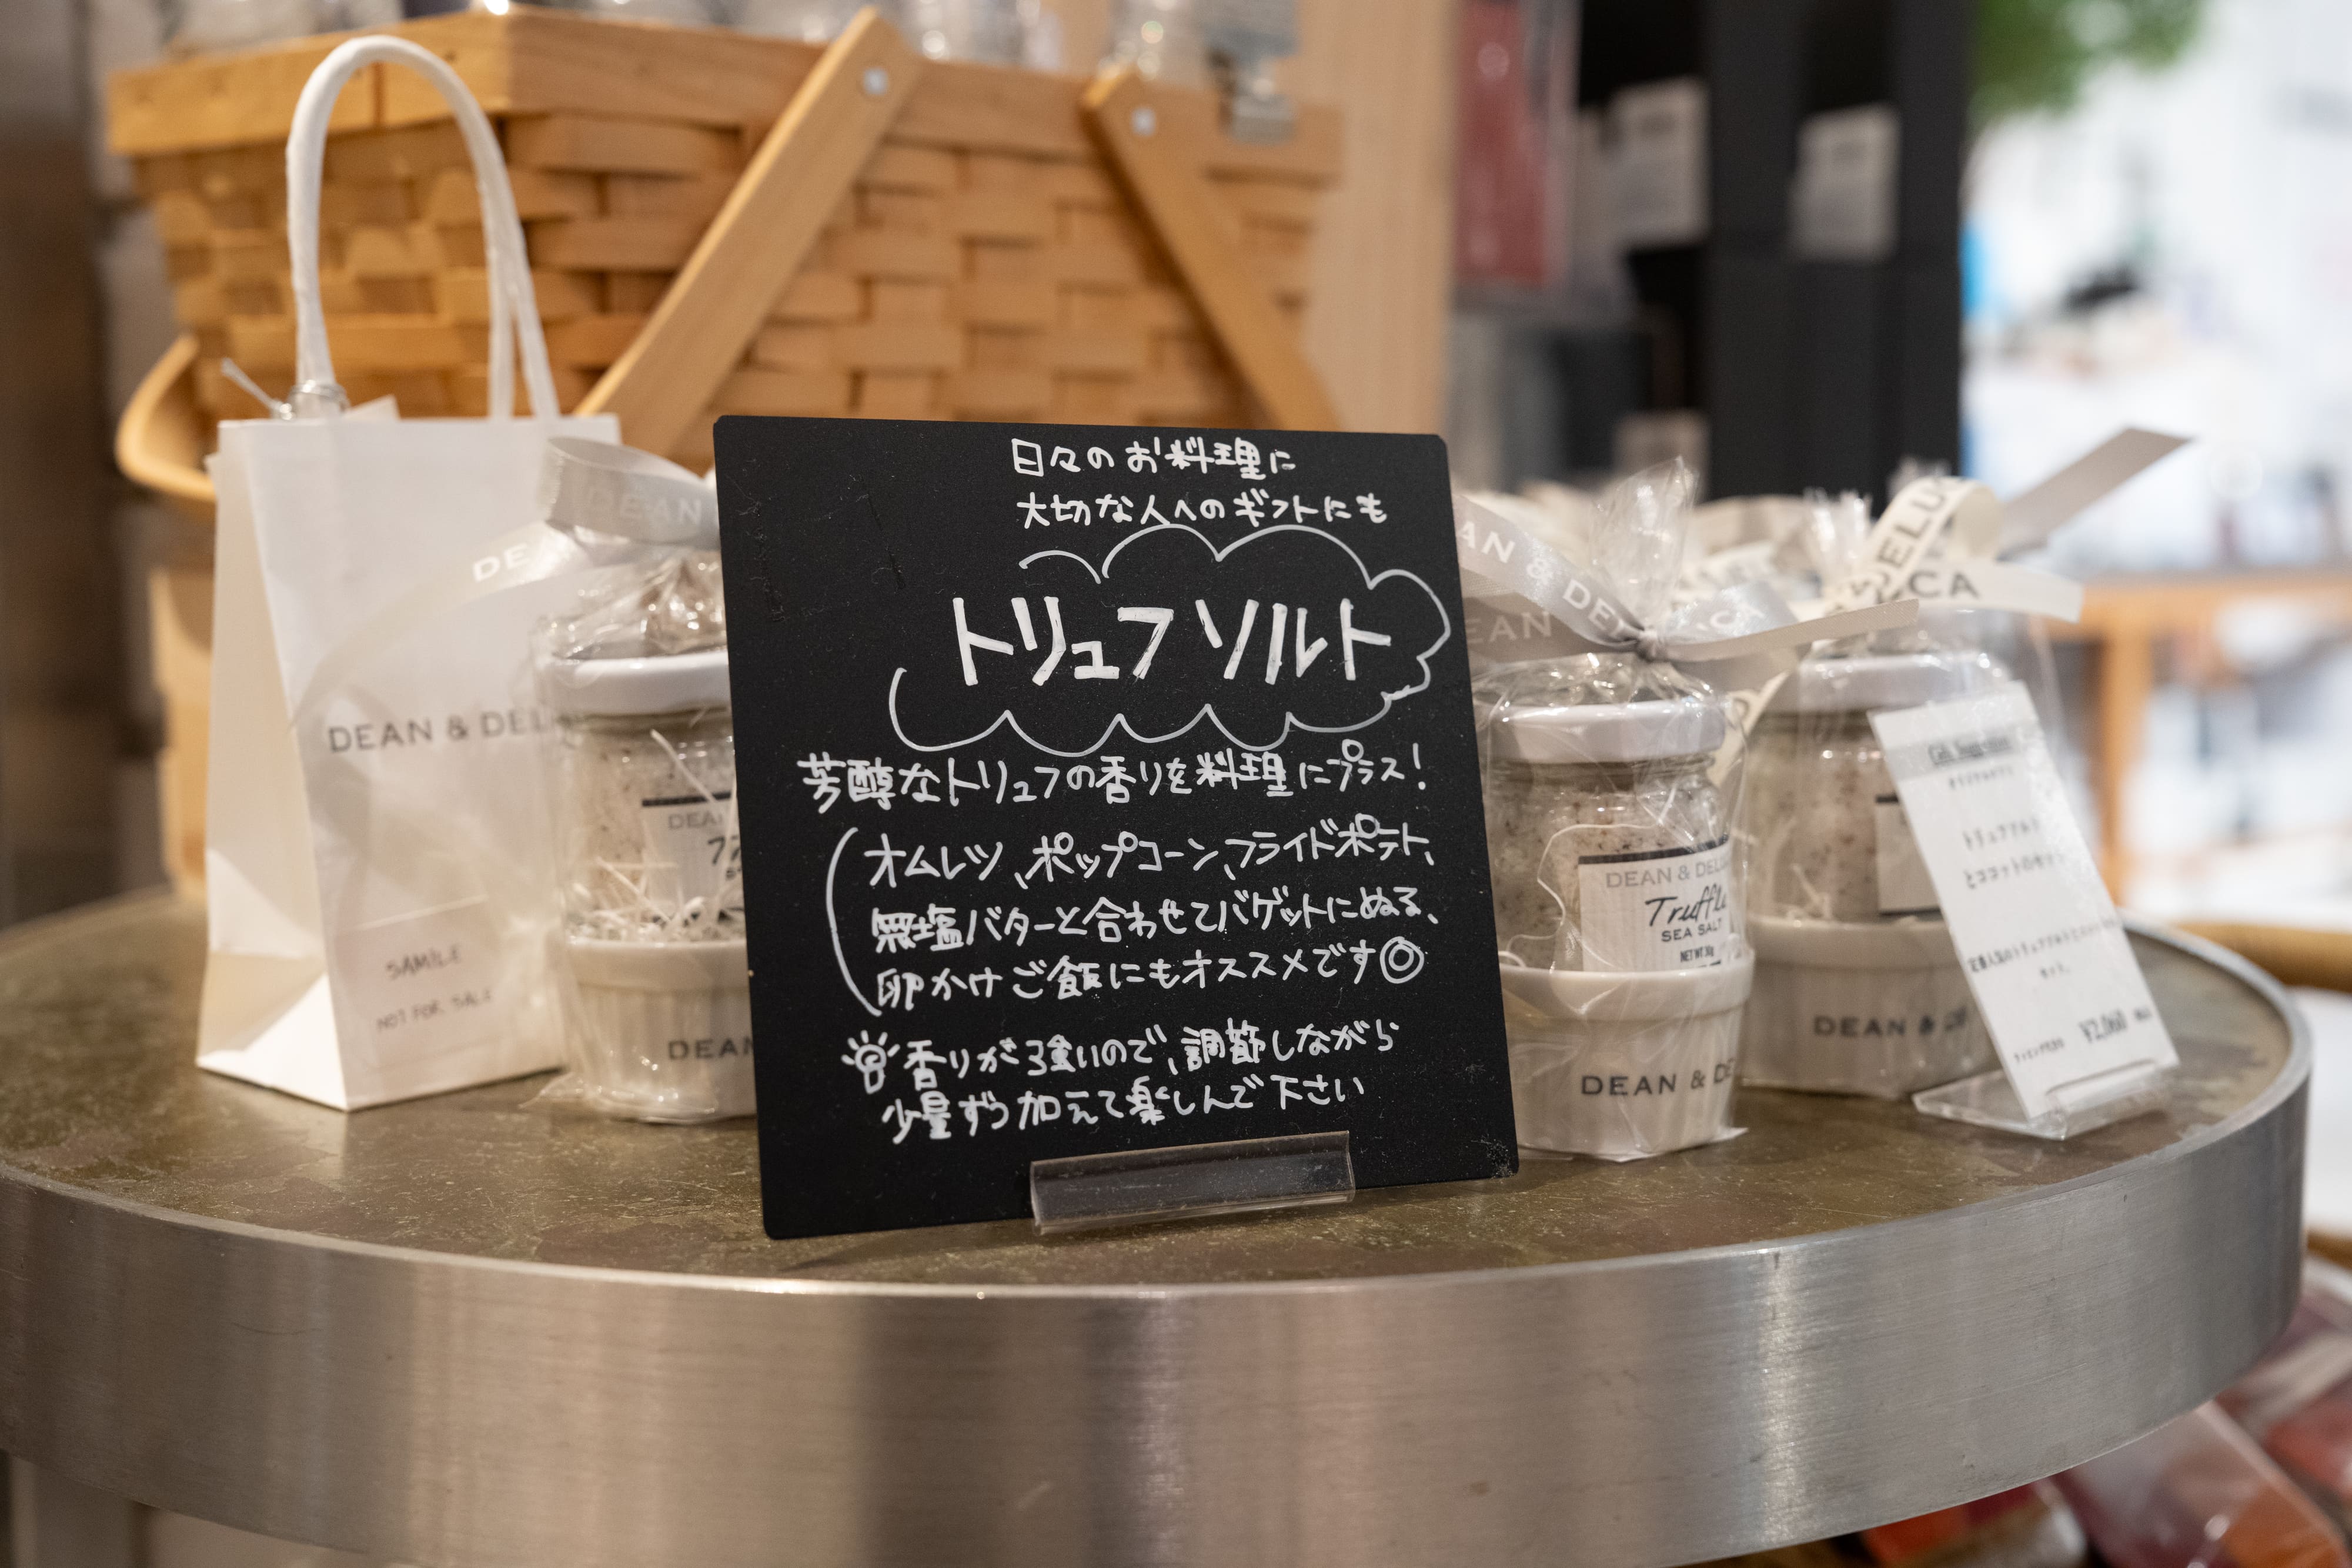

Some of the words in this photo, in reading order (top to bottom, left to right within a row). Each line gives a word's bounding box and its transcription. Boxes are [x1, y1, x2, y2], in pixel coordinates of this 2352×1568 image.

[1011, 436, 1296, 480] 日々のお料理に
[1016, 489, 1387, 529] 大切な人へのギフトにも
[329, 717, 432, 754] DEAN
[447, 713, 468, 741] &
[1606, 867, 1672, 888] DEAN
[1678, 864, 1690, 880] &
[1661, 927, 1692, 942] SEA
[1698, 918, 1722, 936] SALT
[1813, 1015, 1906, 1037] DEAN
[1582, 1073, 1676, 1096] DEAN
[1690, 1069, 1705, 1089] &
[881, 1074, 1364, 1144] 少量ずつ加えて楽しんで下さい
